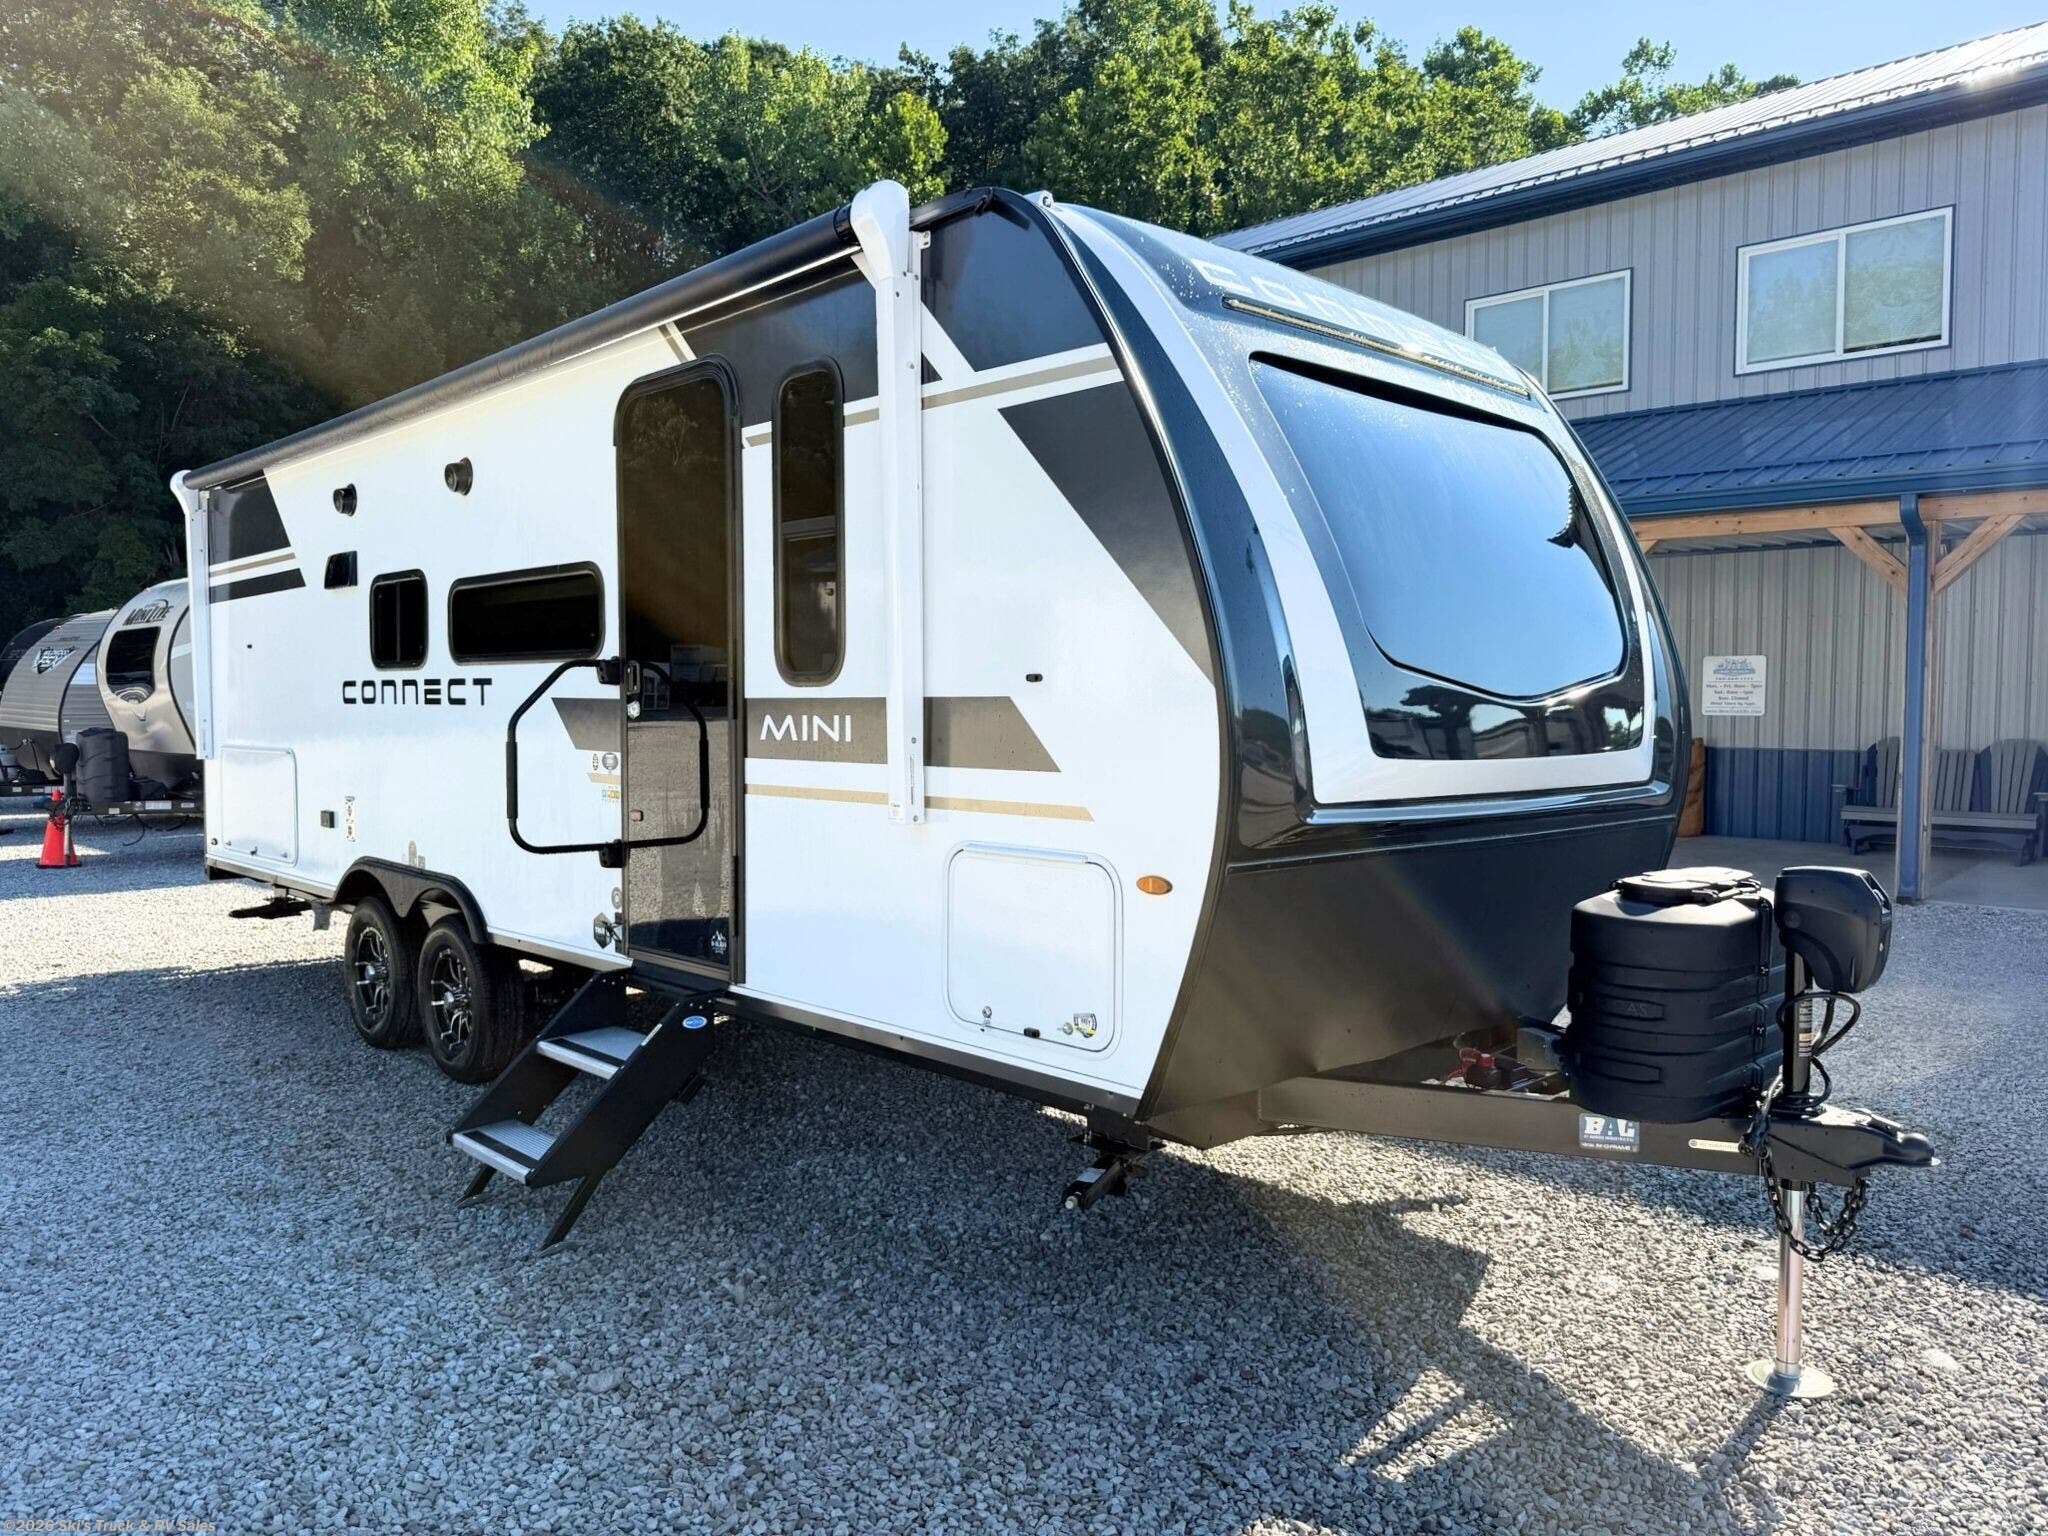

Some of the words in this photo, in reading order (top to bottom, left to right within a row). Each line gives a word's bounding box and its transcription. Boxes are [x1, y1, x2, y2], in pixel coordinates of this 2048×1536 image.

[1190, 258, 1517, 378] CONNE
[342, 677, 493, 706] CONNECT
[760, 714, 852, 742] MINI
